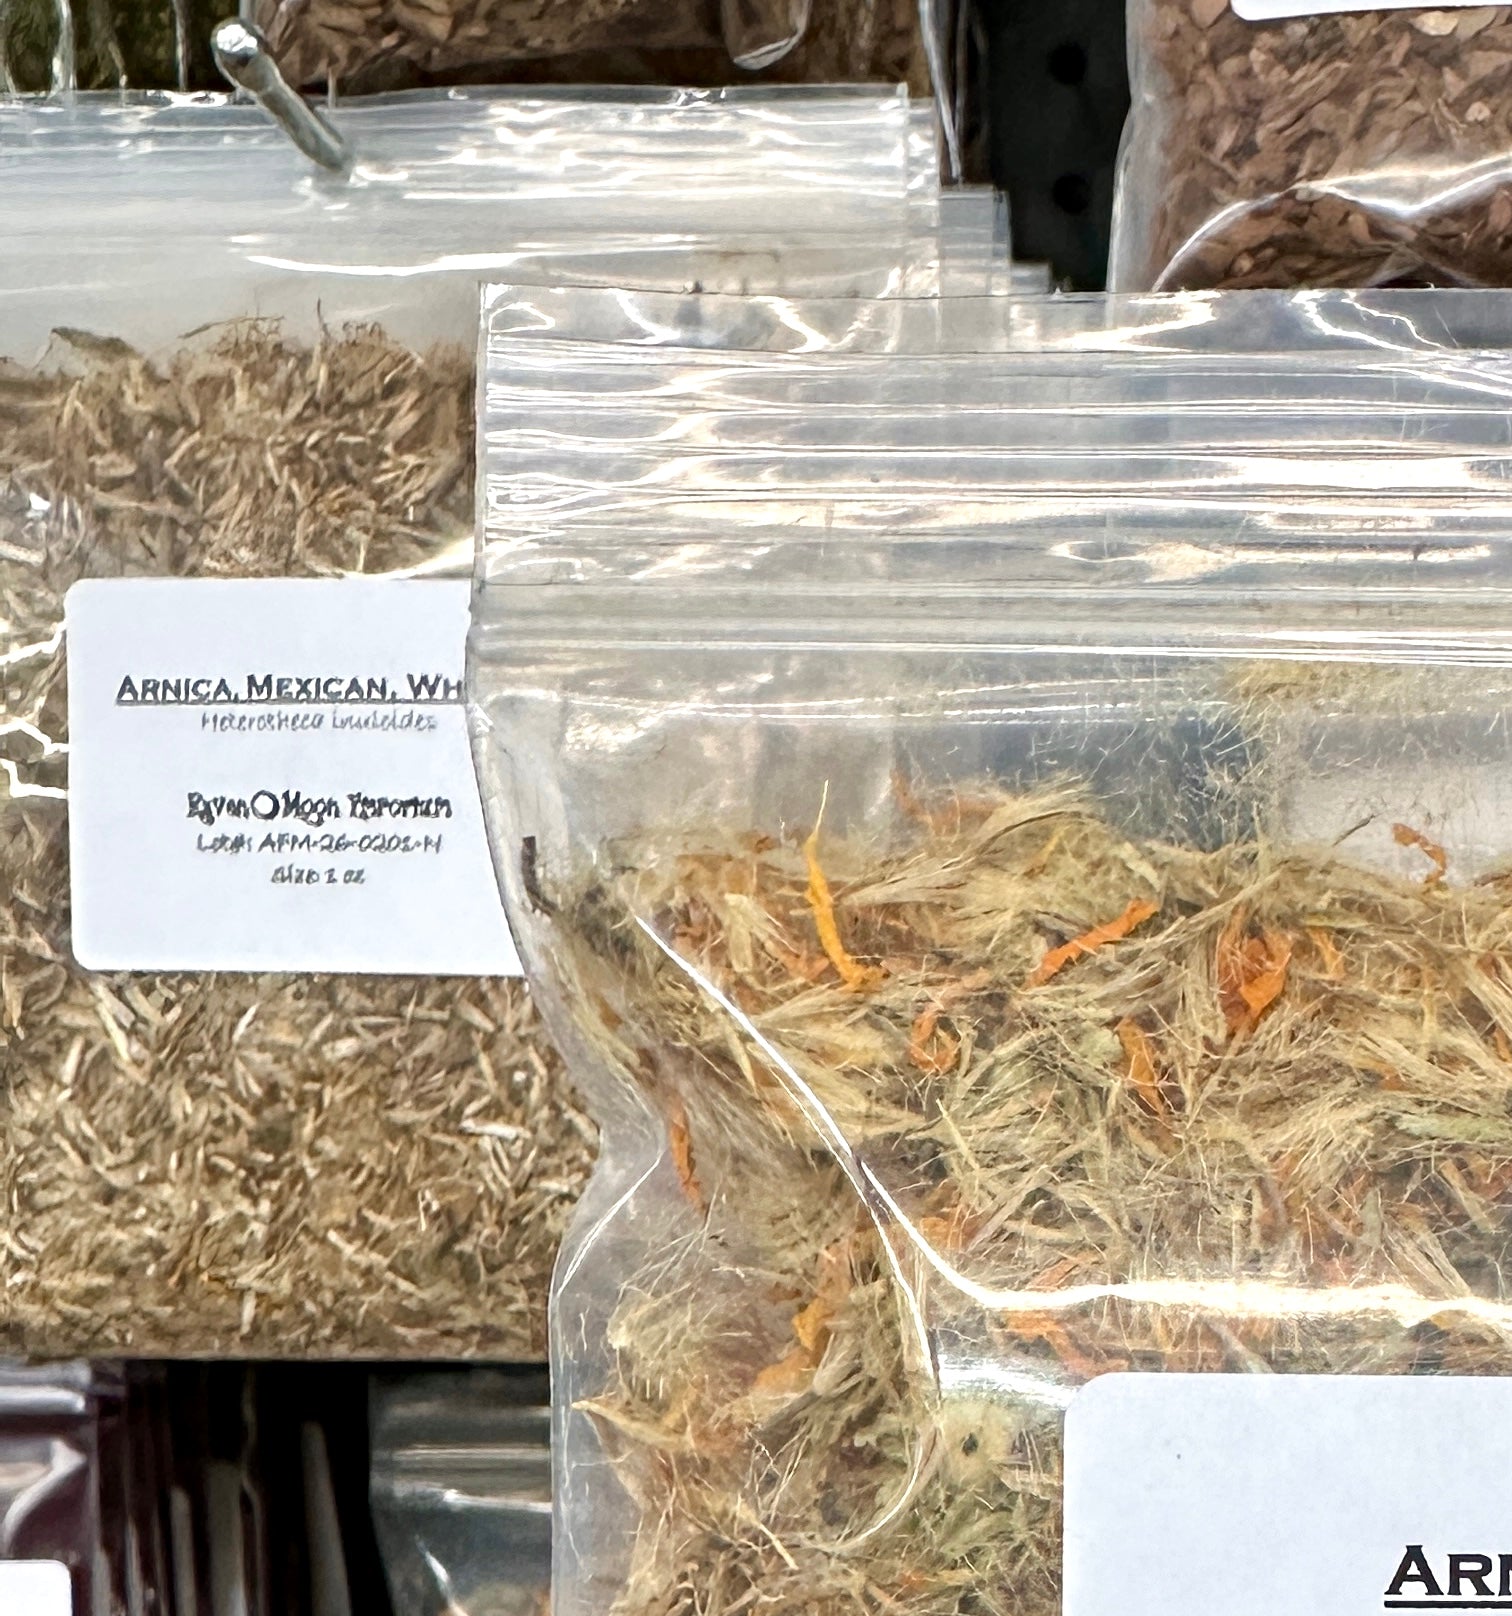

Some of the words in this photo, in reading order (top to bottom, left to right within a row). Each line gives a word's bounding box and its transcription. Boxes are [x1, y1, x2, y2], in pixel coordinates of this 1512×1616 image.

[115, 673, 242, 700] ARNICA,
[247, 673, 398, 700] MEXICAN,
[407, 672, 465, 701] WH
